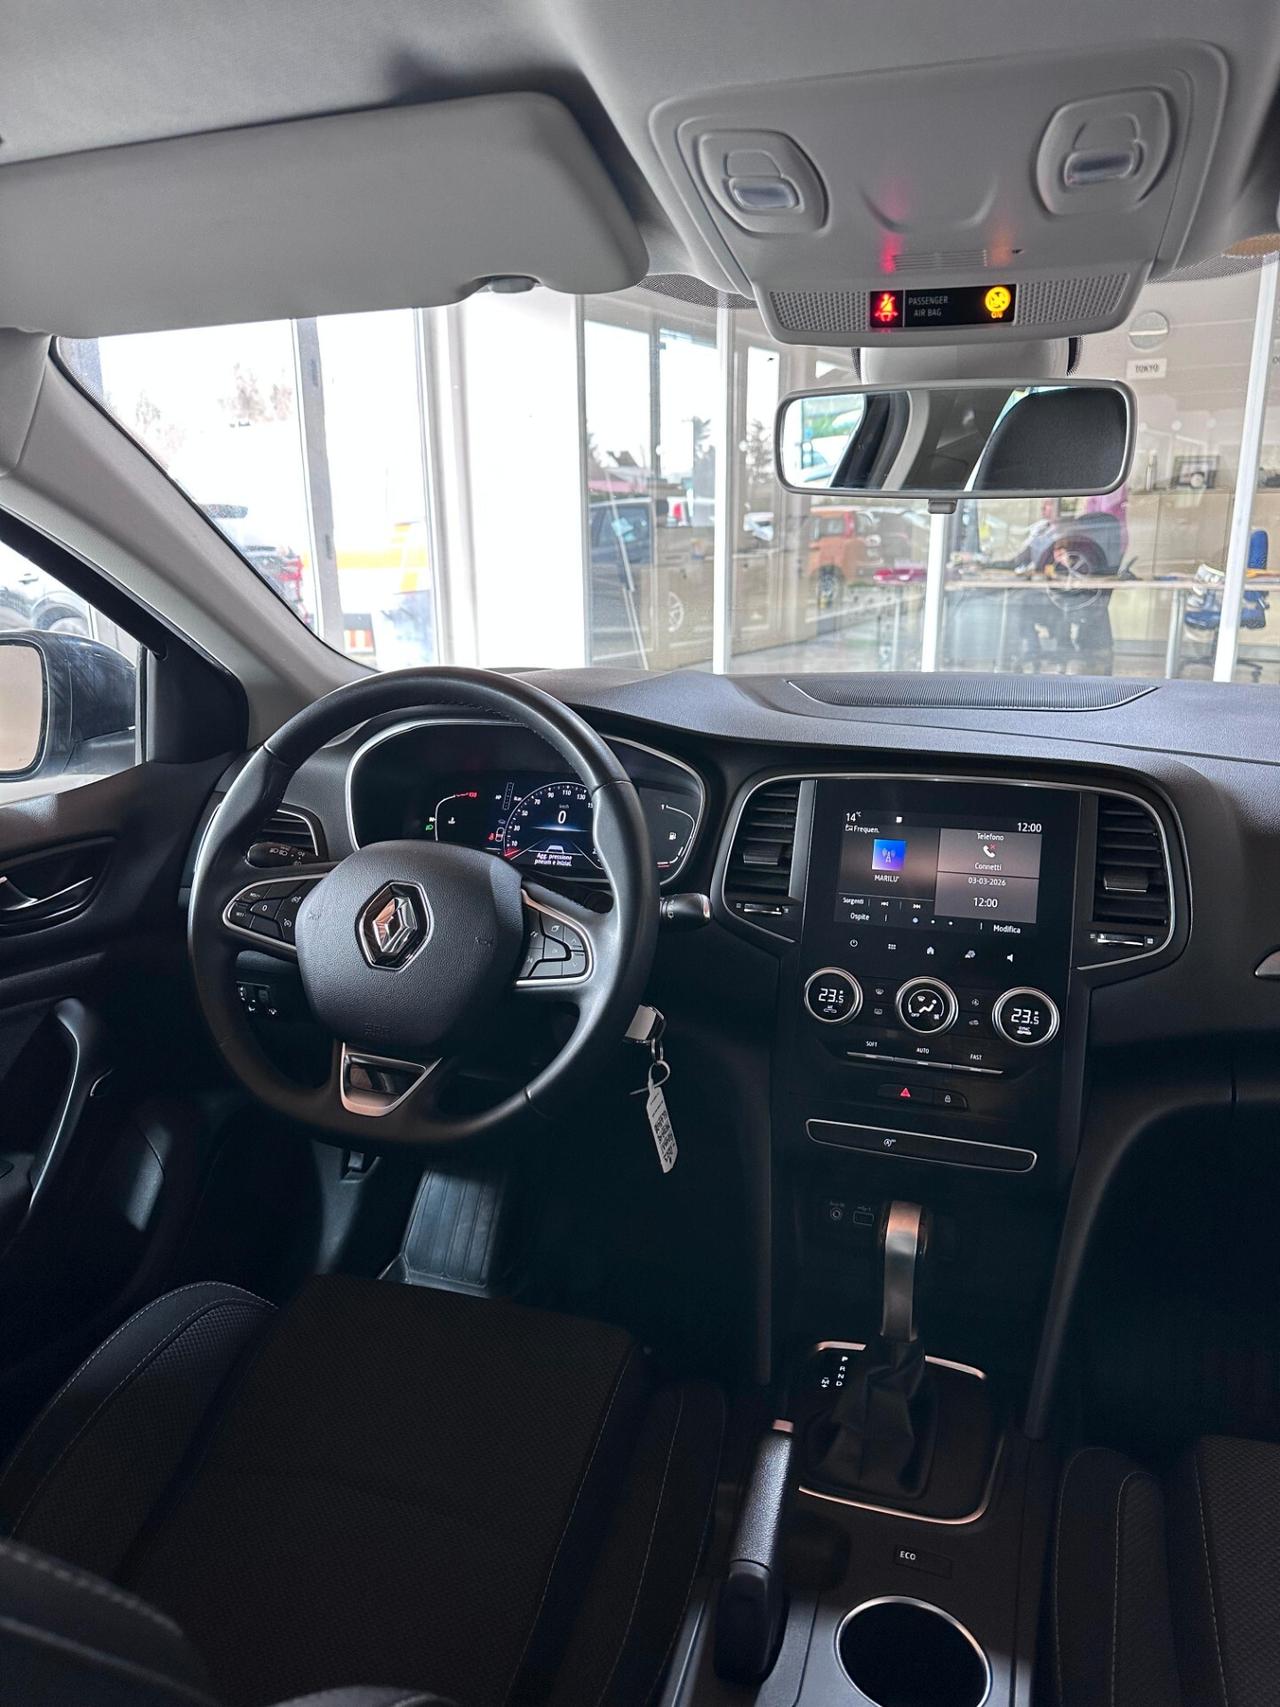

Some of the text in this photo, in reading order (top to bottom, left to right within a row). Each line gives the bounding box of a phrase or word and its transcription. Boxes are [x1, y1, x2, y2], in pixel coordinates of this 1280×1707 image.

[908, 295, 948, 305] PASSENGER
[928, 308, 942, 316] BAG
[557, 810, 567, 824] 0
[1017, 822, 1042, 833] 12:00
[976, 832, 1004, 841] Telefono
[974, 862, 1002, 871] Connetti
[968, 877, 1006, 886] 03-03-2026
[842, 897, 865, 905] Sorgenti
[973, 897, 998, 908] 12:00
[850, 912, 870, 921] Ospite
[993, 924, 1021, 934] Modifica
[900, 1550, 917, 1560] ECO
